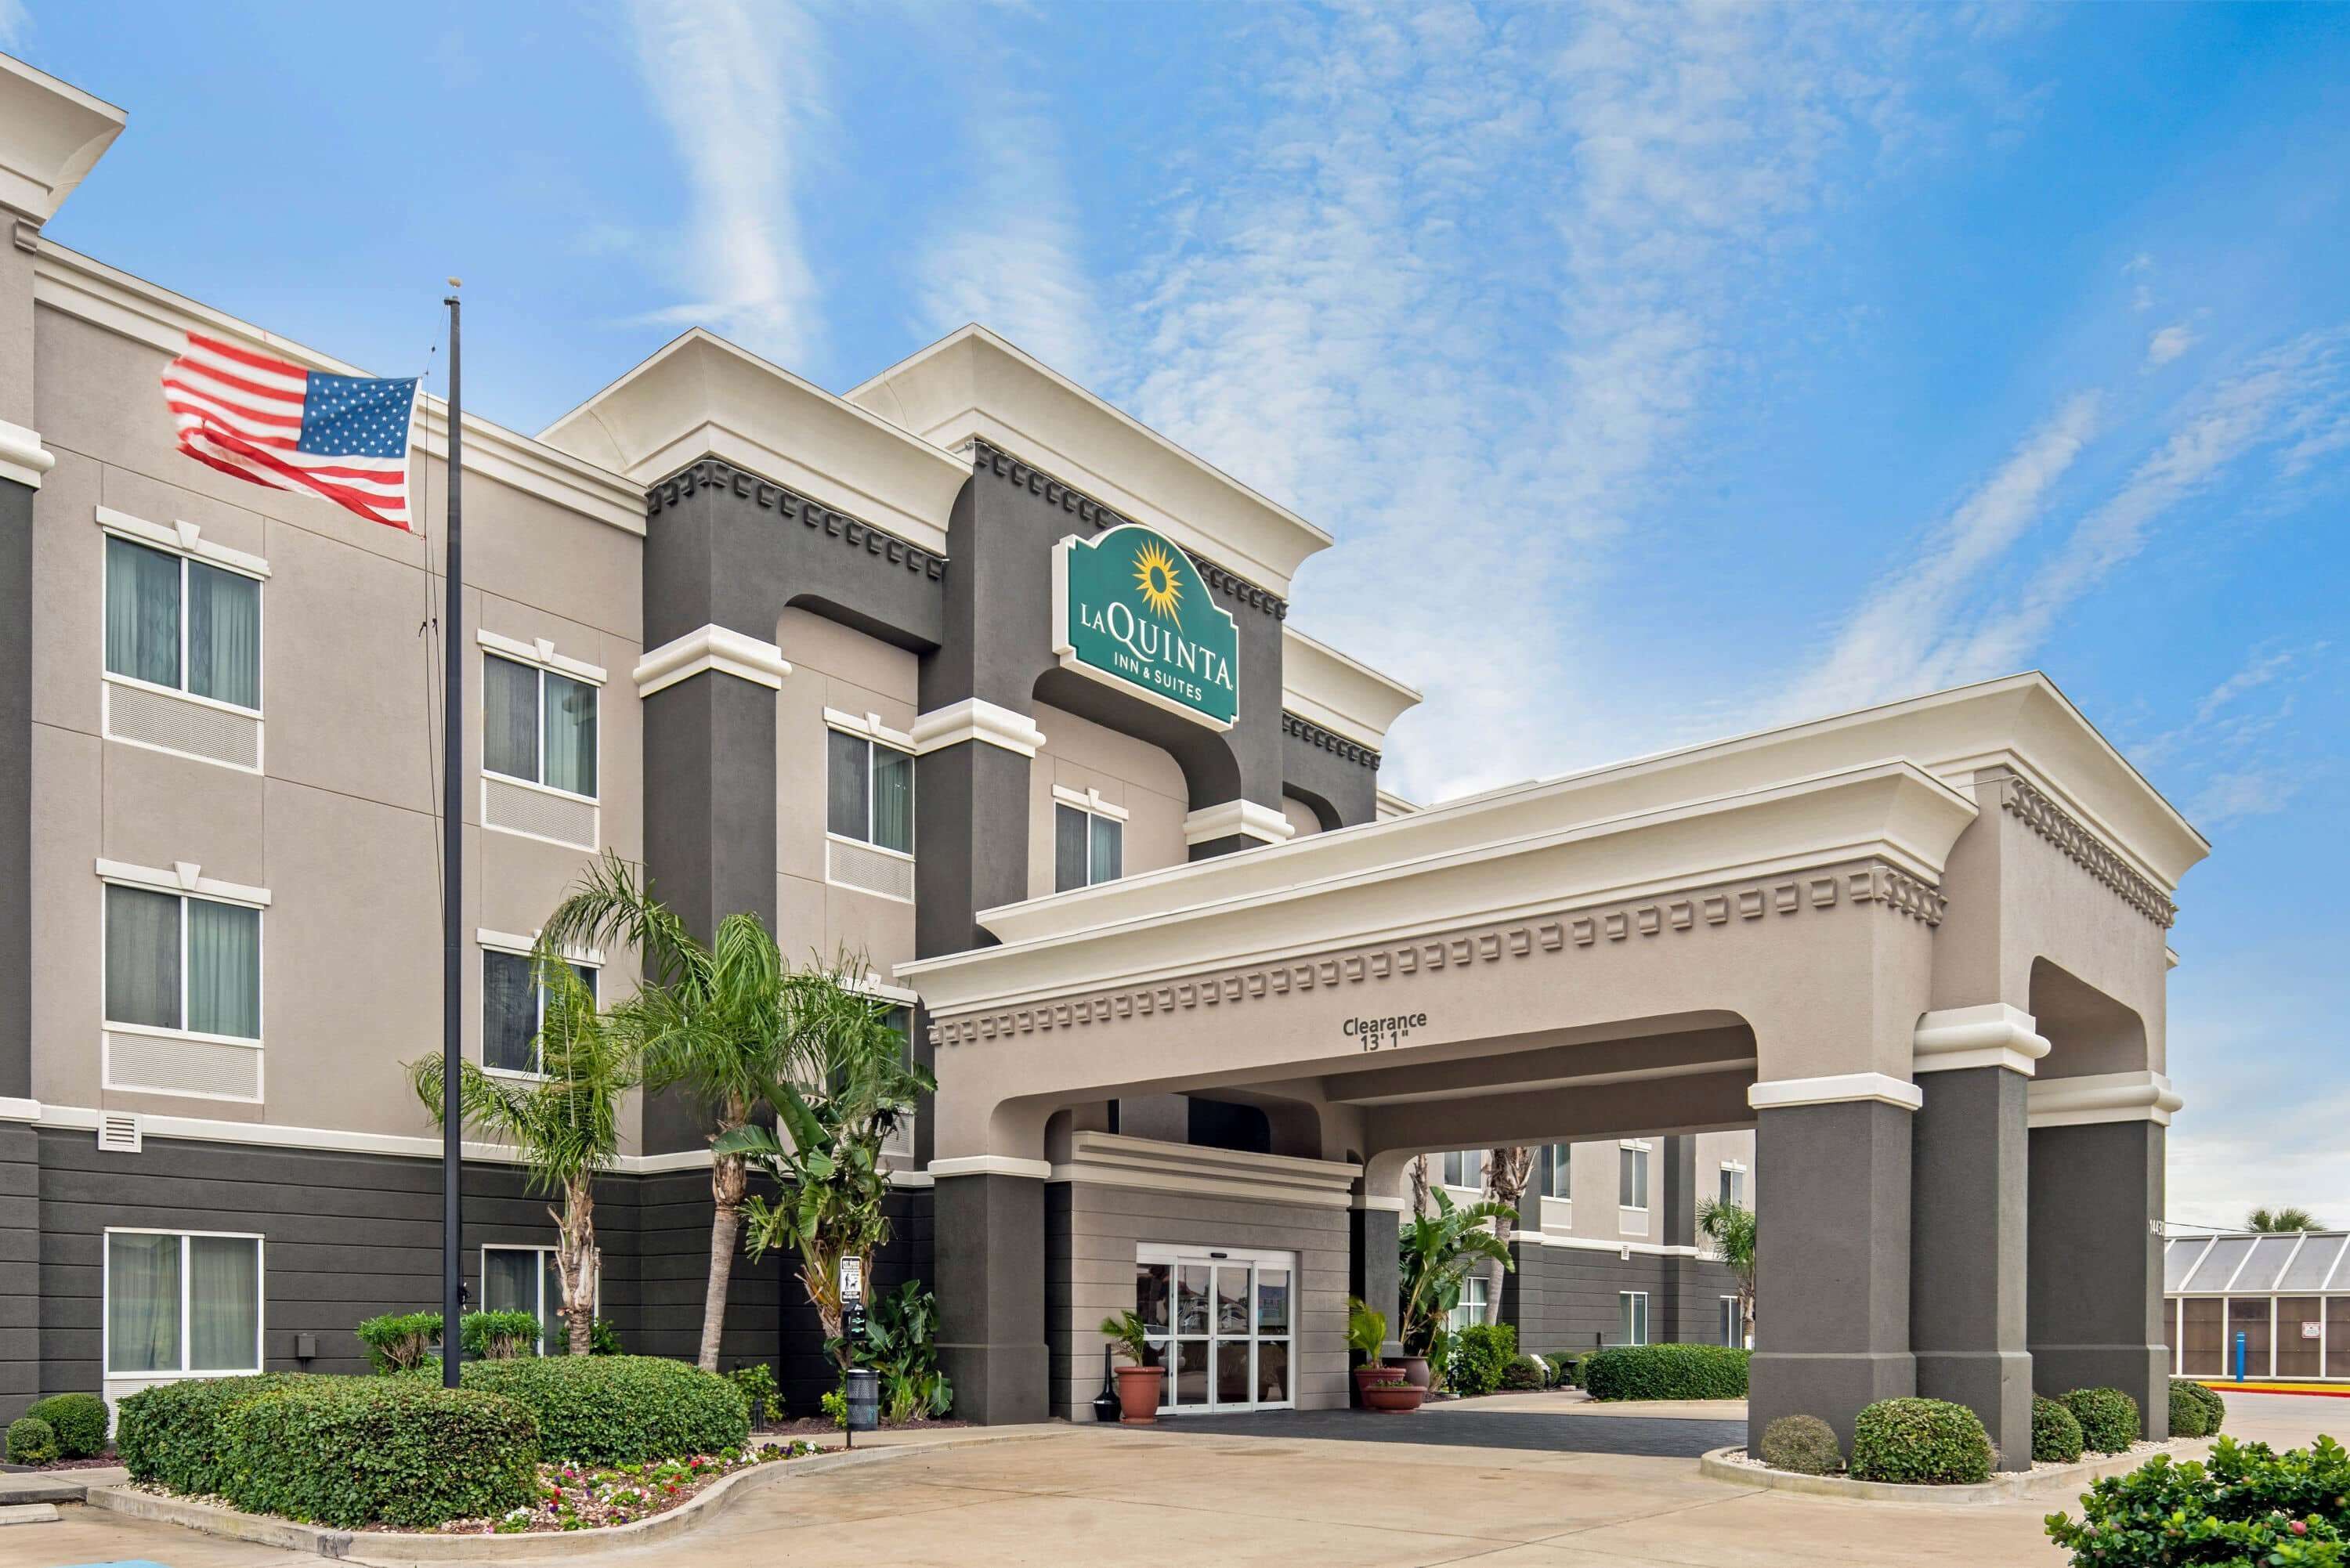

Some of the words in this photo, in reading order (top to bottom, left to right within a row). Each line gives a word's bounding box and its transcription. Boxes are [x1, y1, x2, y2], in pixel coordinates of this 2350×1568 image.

[1080, 603, 1106, 633] LA
[1107, 602, 1233, 691] QUINTA
[1115, 652, 1139, 674] INN
[1143, 667, 1150, 679] &
[1155, 670, 1202, 701] SUITES
[1343, 1013, 1426, 1036] Clearance
[1361, 1033, 1384, 1051] 13'
